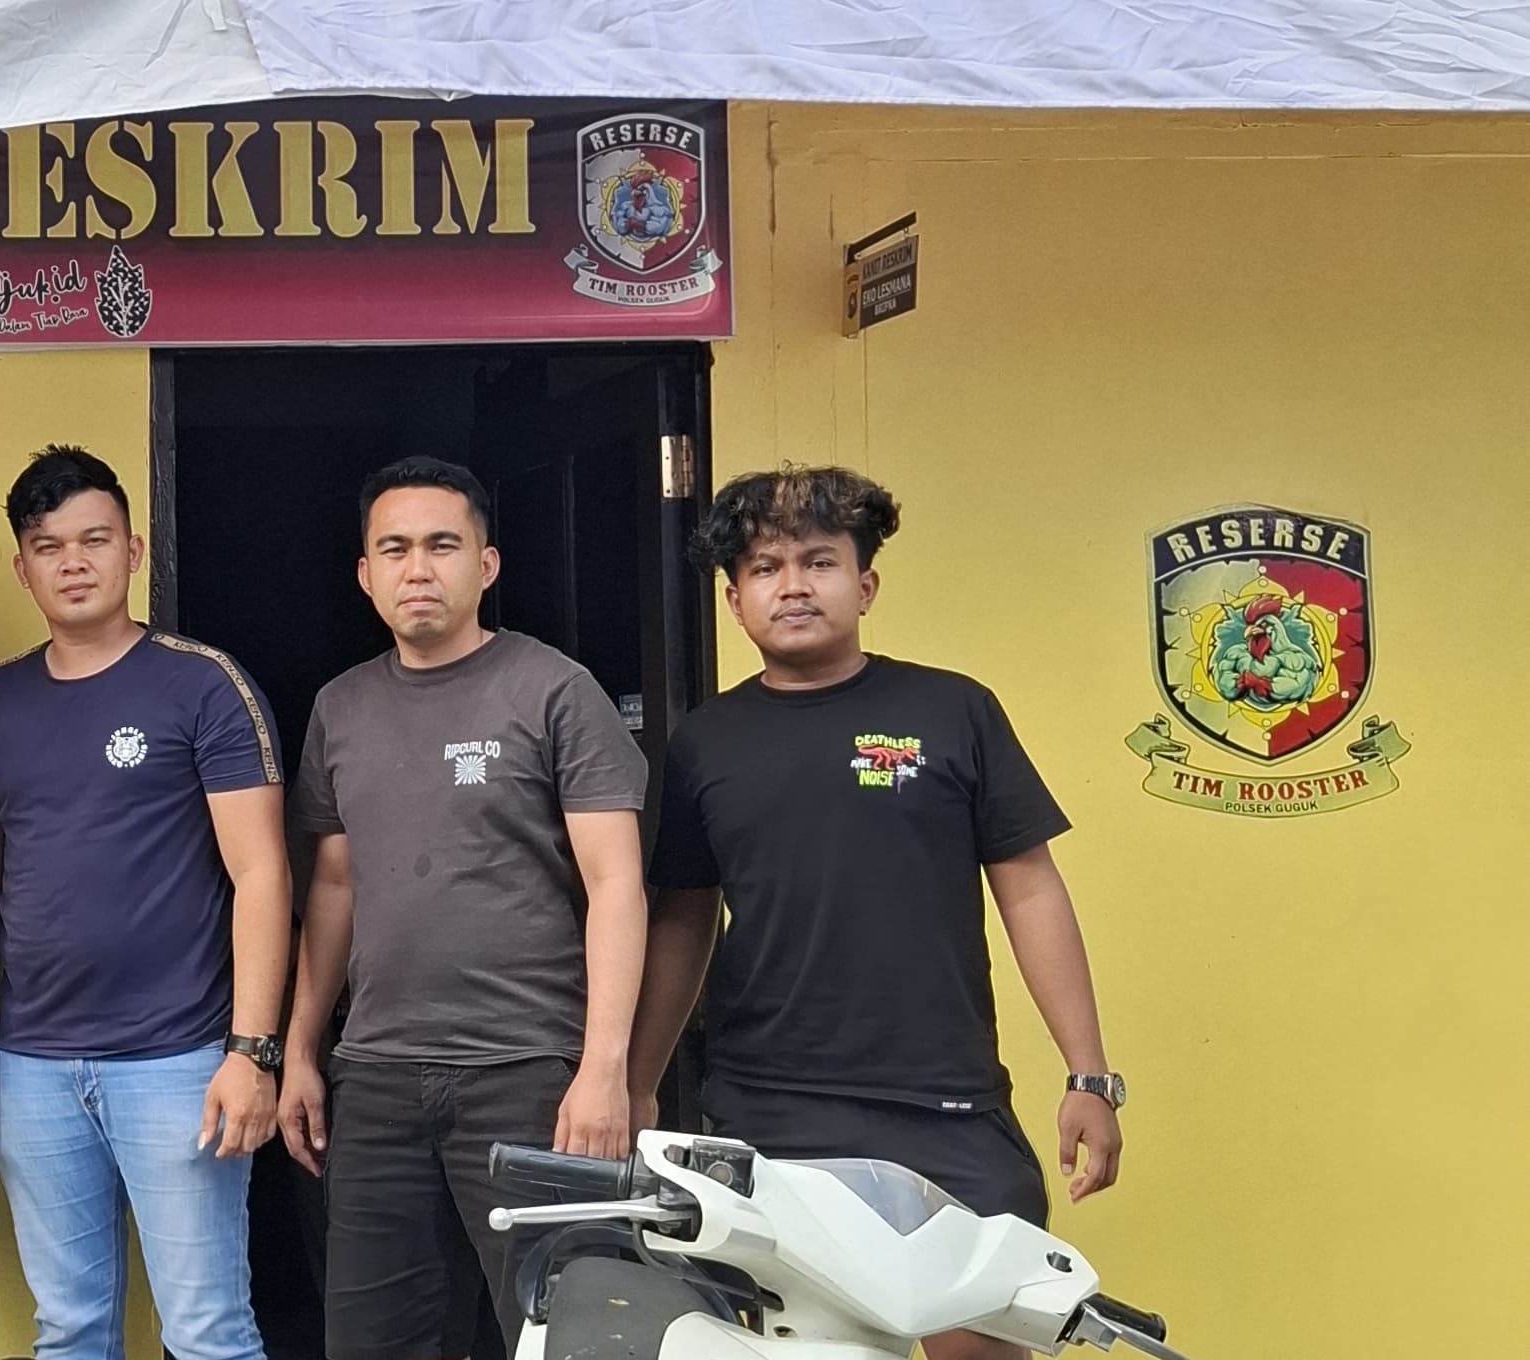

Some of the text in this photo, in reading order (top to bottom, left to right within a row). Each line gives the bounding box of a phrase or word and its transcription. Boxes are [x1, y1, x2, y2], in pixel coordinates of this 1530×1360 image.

[589, 122, 693, 151] RESERSE
[588, 277, 699, 297] TIM ROOSTER
[1167, 518, 1349, 564] RESERSE
[246, 696, 267, 735] KENZO
[485, 740, 501, 758] CO
[854, 734, 922, 750] DEATHLESS
[858, 770, 895, 787] NOISE
[1173, 769, 1370, 801] TIM ROOSTER
[1225, 800, 1319, 814] POLSEK GUGUK
